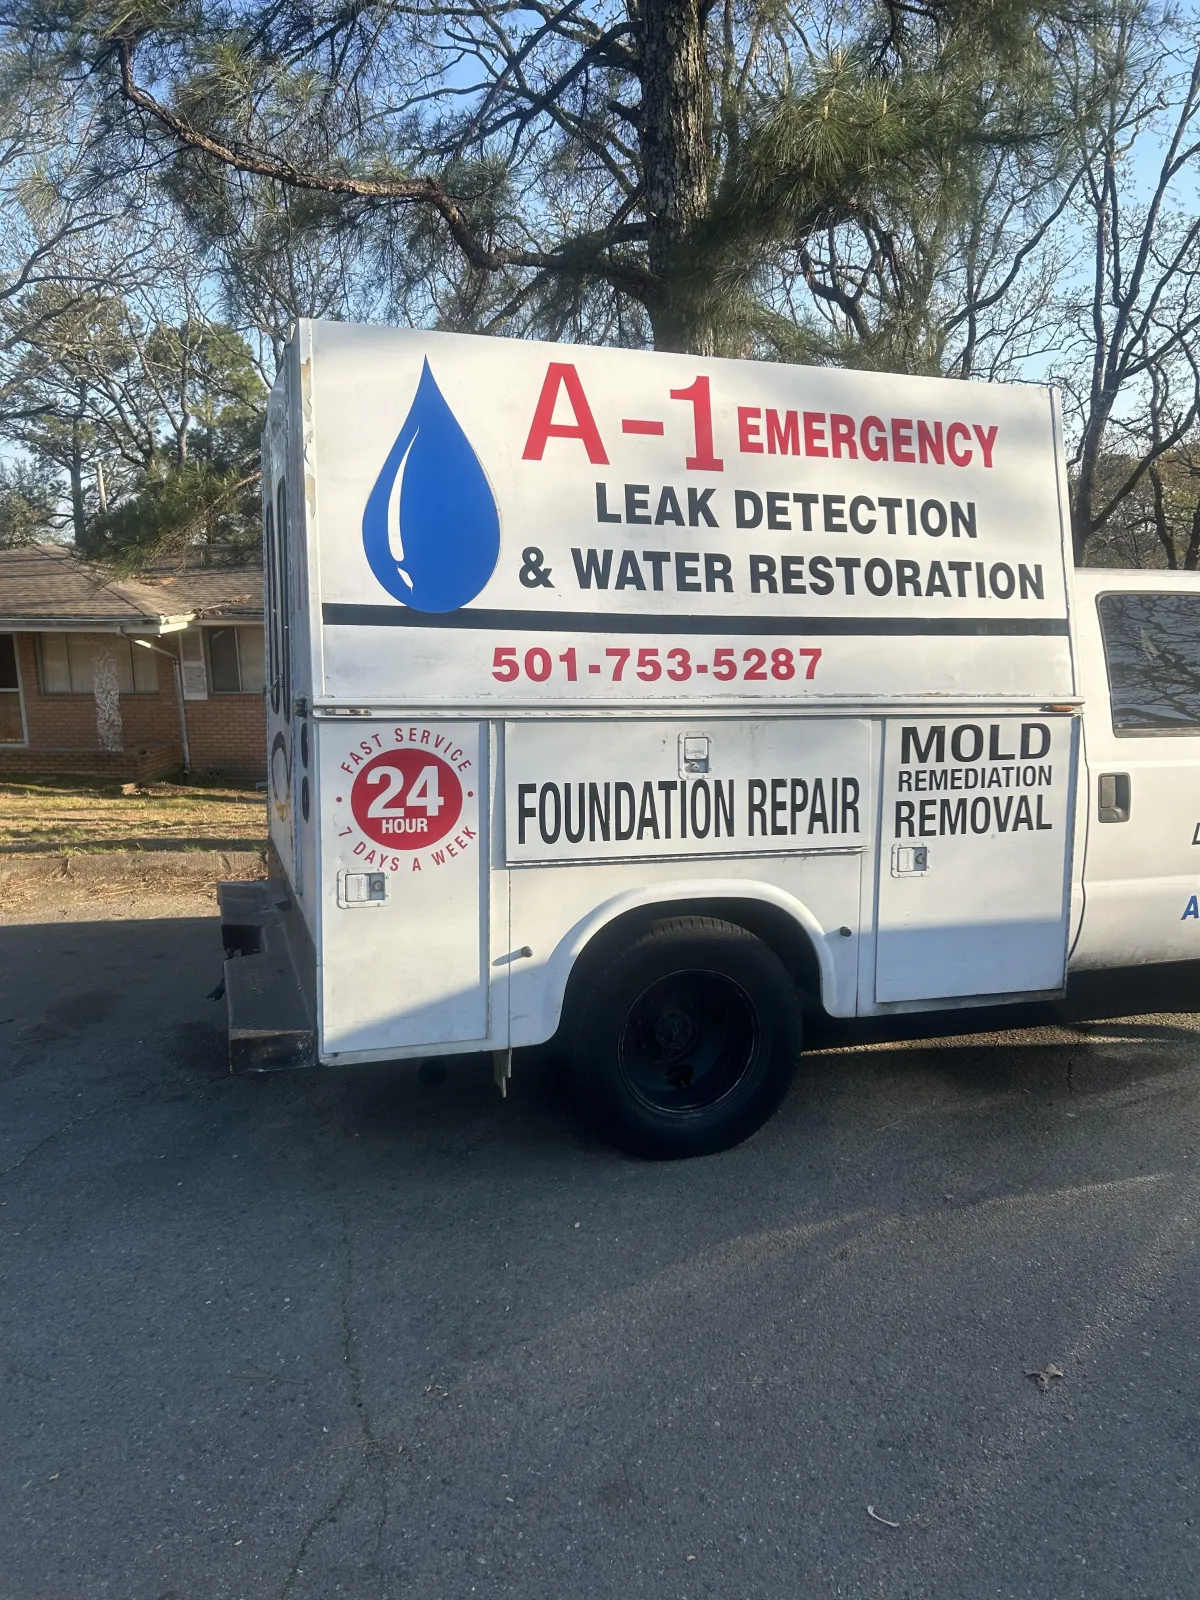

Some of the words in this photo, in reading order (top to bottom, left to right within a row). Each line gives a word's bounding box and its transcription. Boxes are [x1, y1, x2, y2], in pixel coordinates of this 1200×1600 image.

[521, 361, 725, 472] A-1
[737, 405, 999, 468] EMERGENCY
[596, 481, 719, 528] LEAK
[735, 491, 978, 539] DETECTION
[518, 546, 553, 589] &
[571, 547, 733, 594] WATER
[750, 556, 1045, 600] RESTORATION
[492, 647, 823, 682] 501-753-5287
[340, 733, 383, 775] FAST
[394, 727, 473, 772] SERVICE
[900, 723, 1052, 764] MOLD
[366, 765, 445, 819] 24
[898, 765, 1052, 792] REMEDIATION
[381, 817, 428, 835] HOUR
[518, 779, 735, 845] FOUNDATION
[748, 777, 860, 836] REPAIR
[894, 794, 1053, 838] REMOVAL
[338, 826, 353, 838] 7
[352, 840, 400, 872] DAYS
[412, 857, 422, 872] A
[431, 825, 477, 866] WEEK
